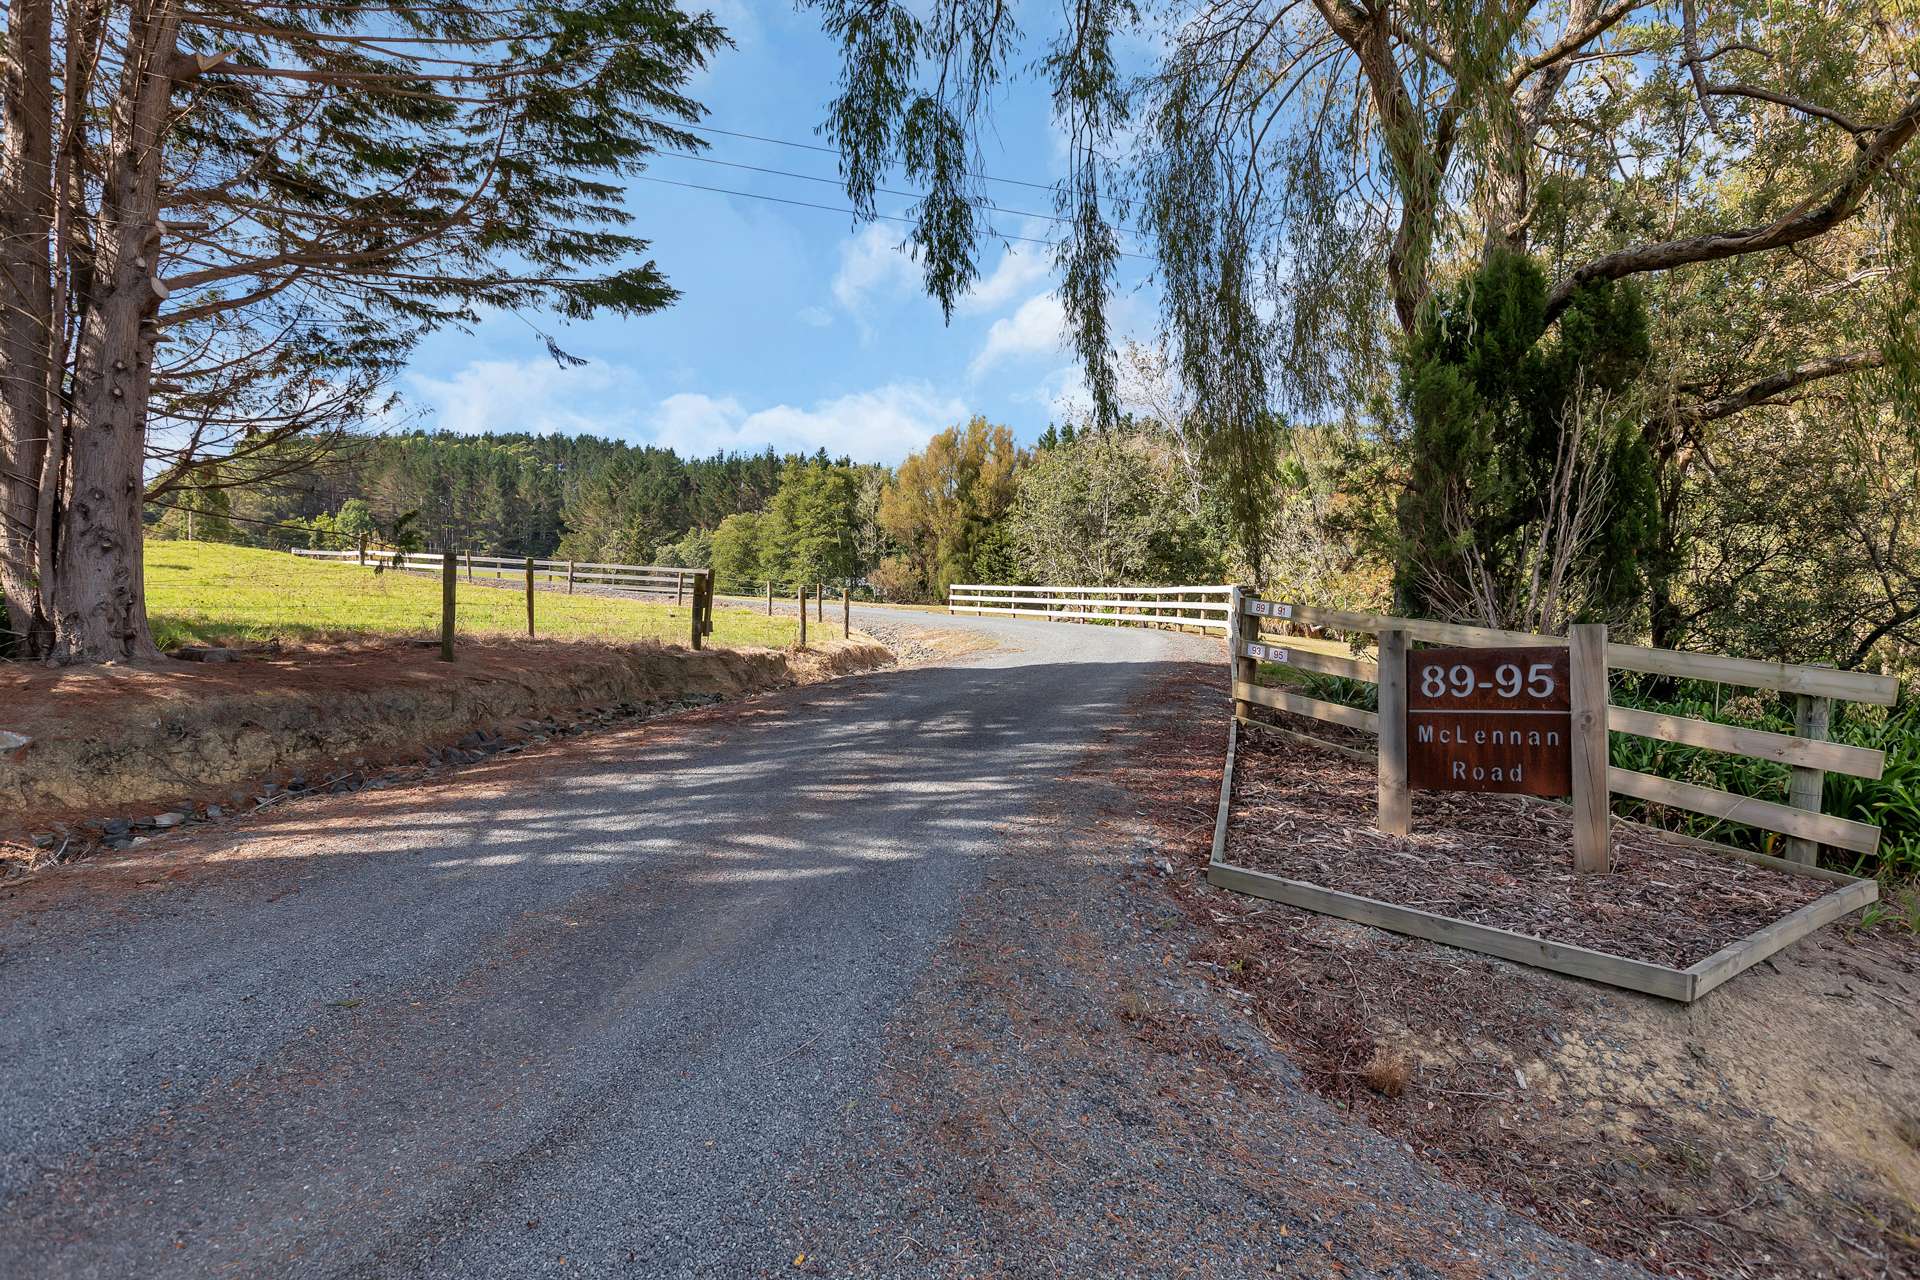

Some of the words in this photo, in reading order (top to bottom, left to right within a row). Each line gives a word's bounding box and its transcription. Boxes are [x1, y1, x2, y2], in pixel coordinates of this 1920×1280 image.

[1255, 603, 1266, 613] 89
[1277, 606, 1286, 615] 91
[1251, 646, 1262, 655] 93
[1273, 650, 1284, 660] 95
[1420, 663, 1555, 698] 89-95
[1418, 724, 1560, 747] McLennan
[1452, 760, 1523, 783] Road
